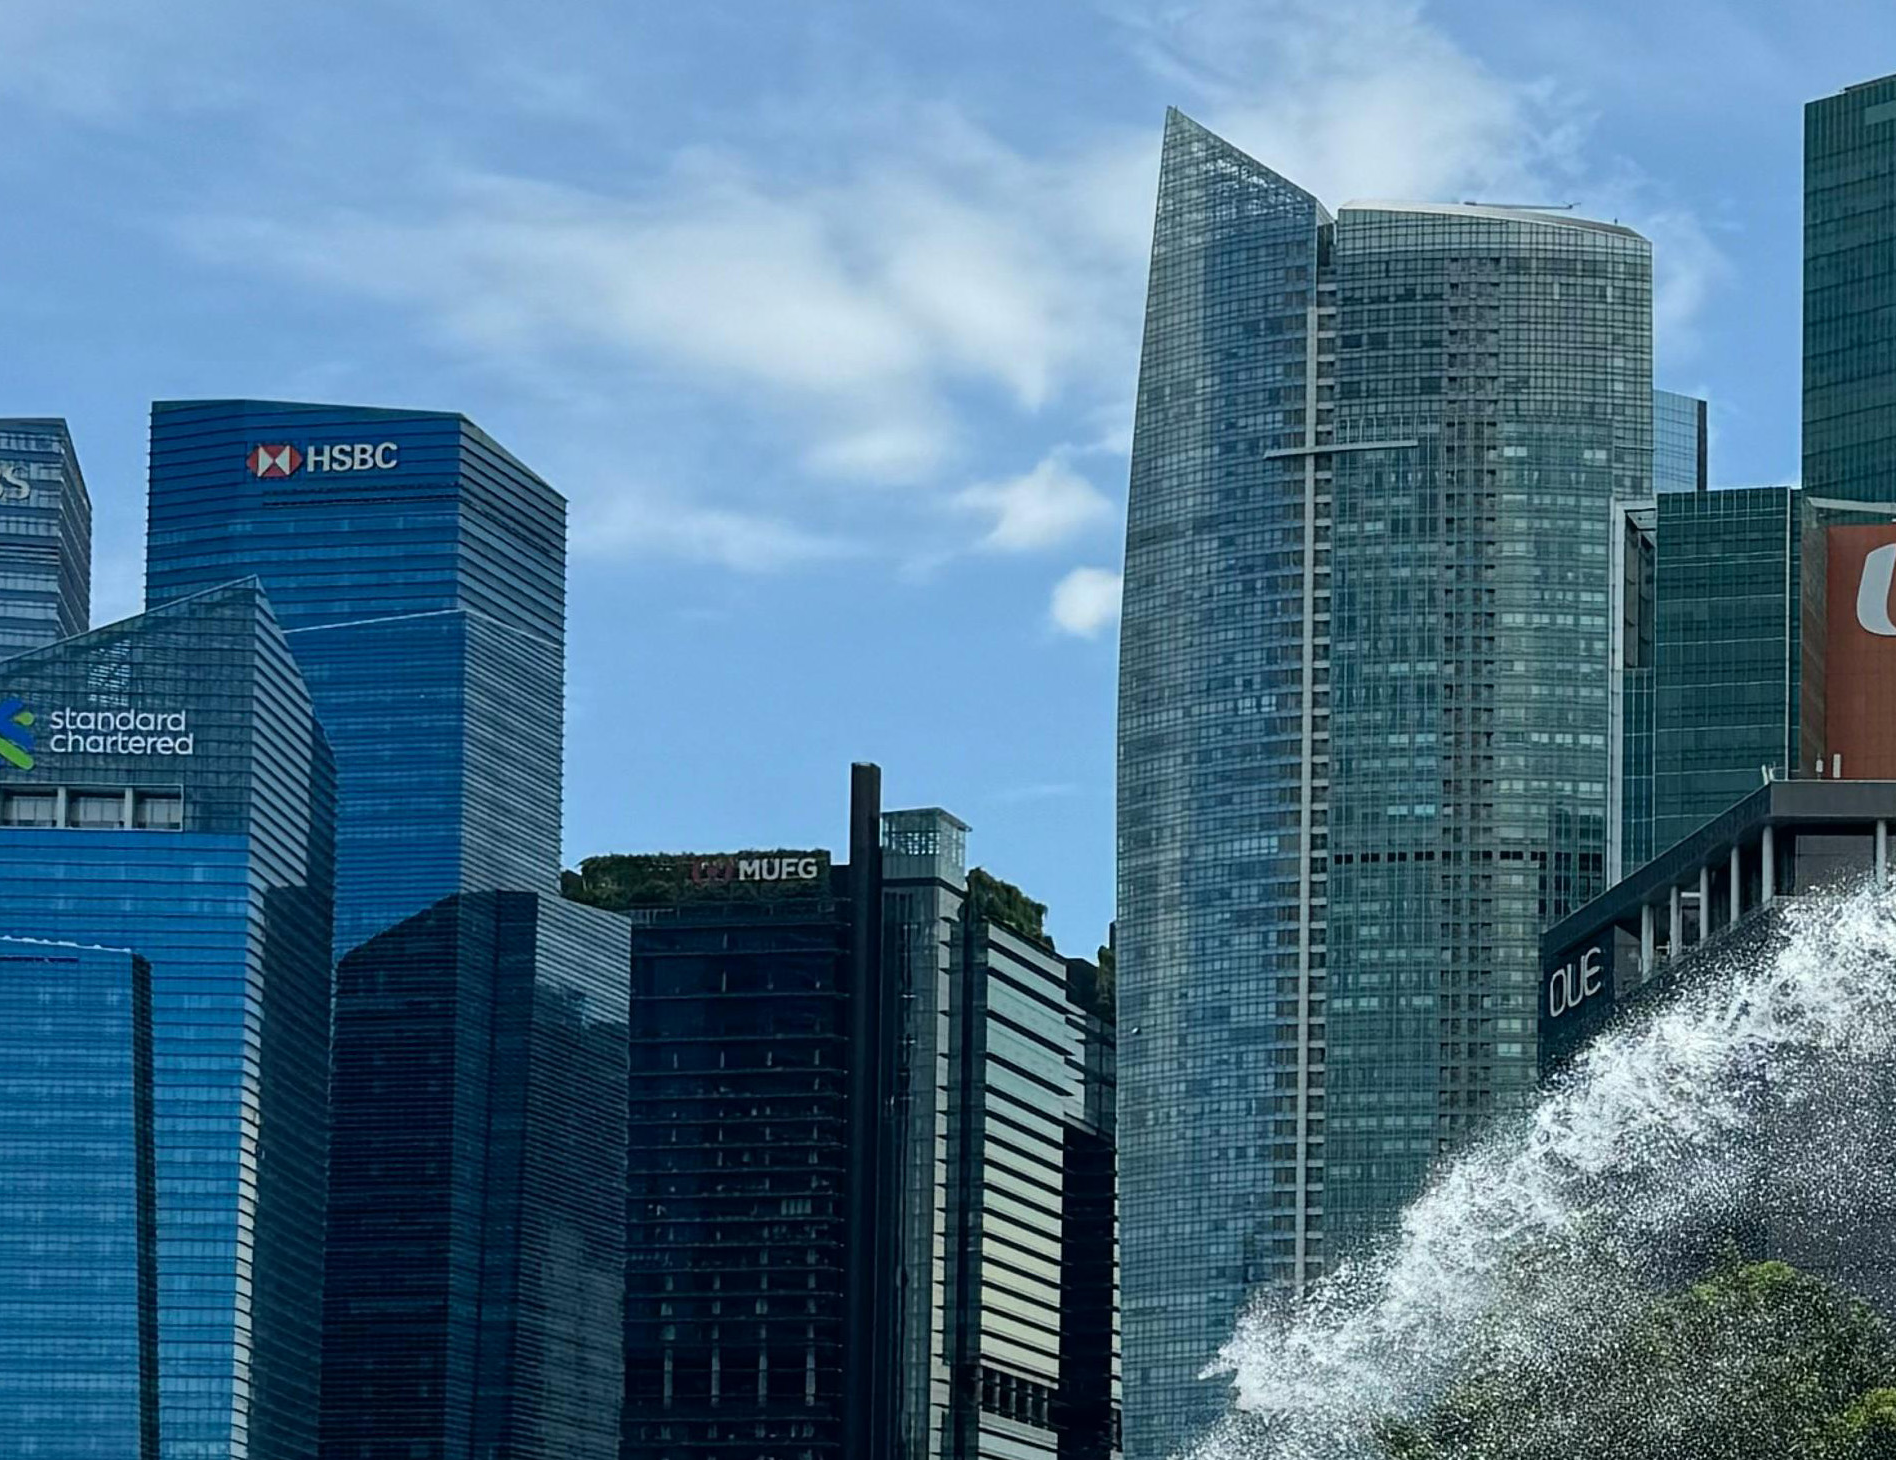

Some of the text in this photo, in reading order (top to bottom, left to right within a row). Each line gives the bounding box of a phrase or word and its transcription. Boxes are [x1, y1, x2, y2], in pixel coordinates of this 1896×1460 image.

[307, 442, 398, 472] HSBC
[50, 707, 186, 731] standard
[50, 731, 194, 755] chartered
[739, 858, 818, 880] MUFG
[1550, 946, 1602, 1017] OUE
